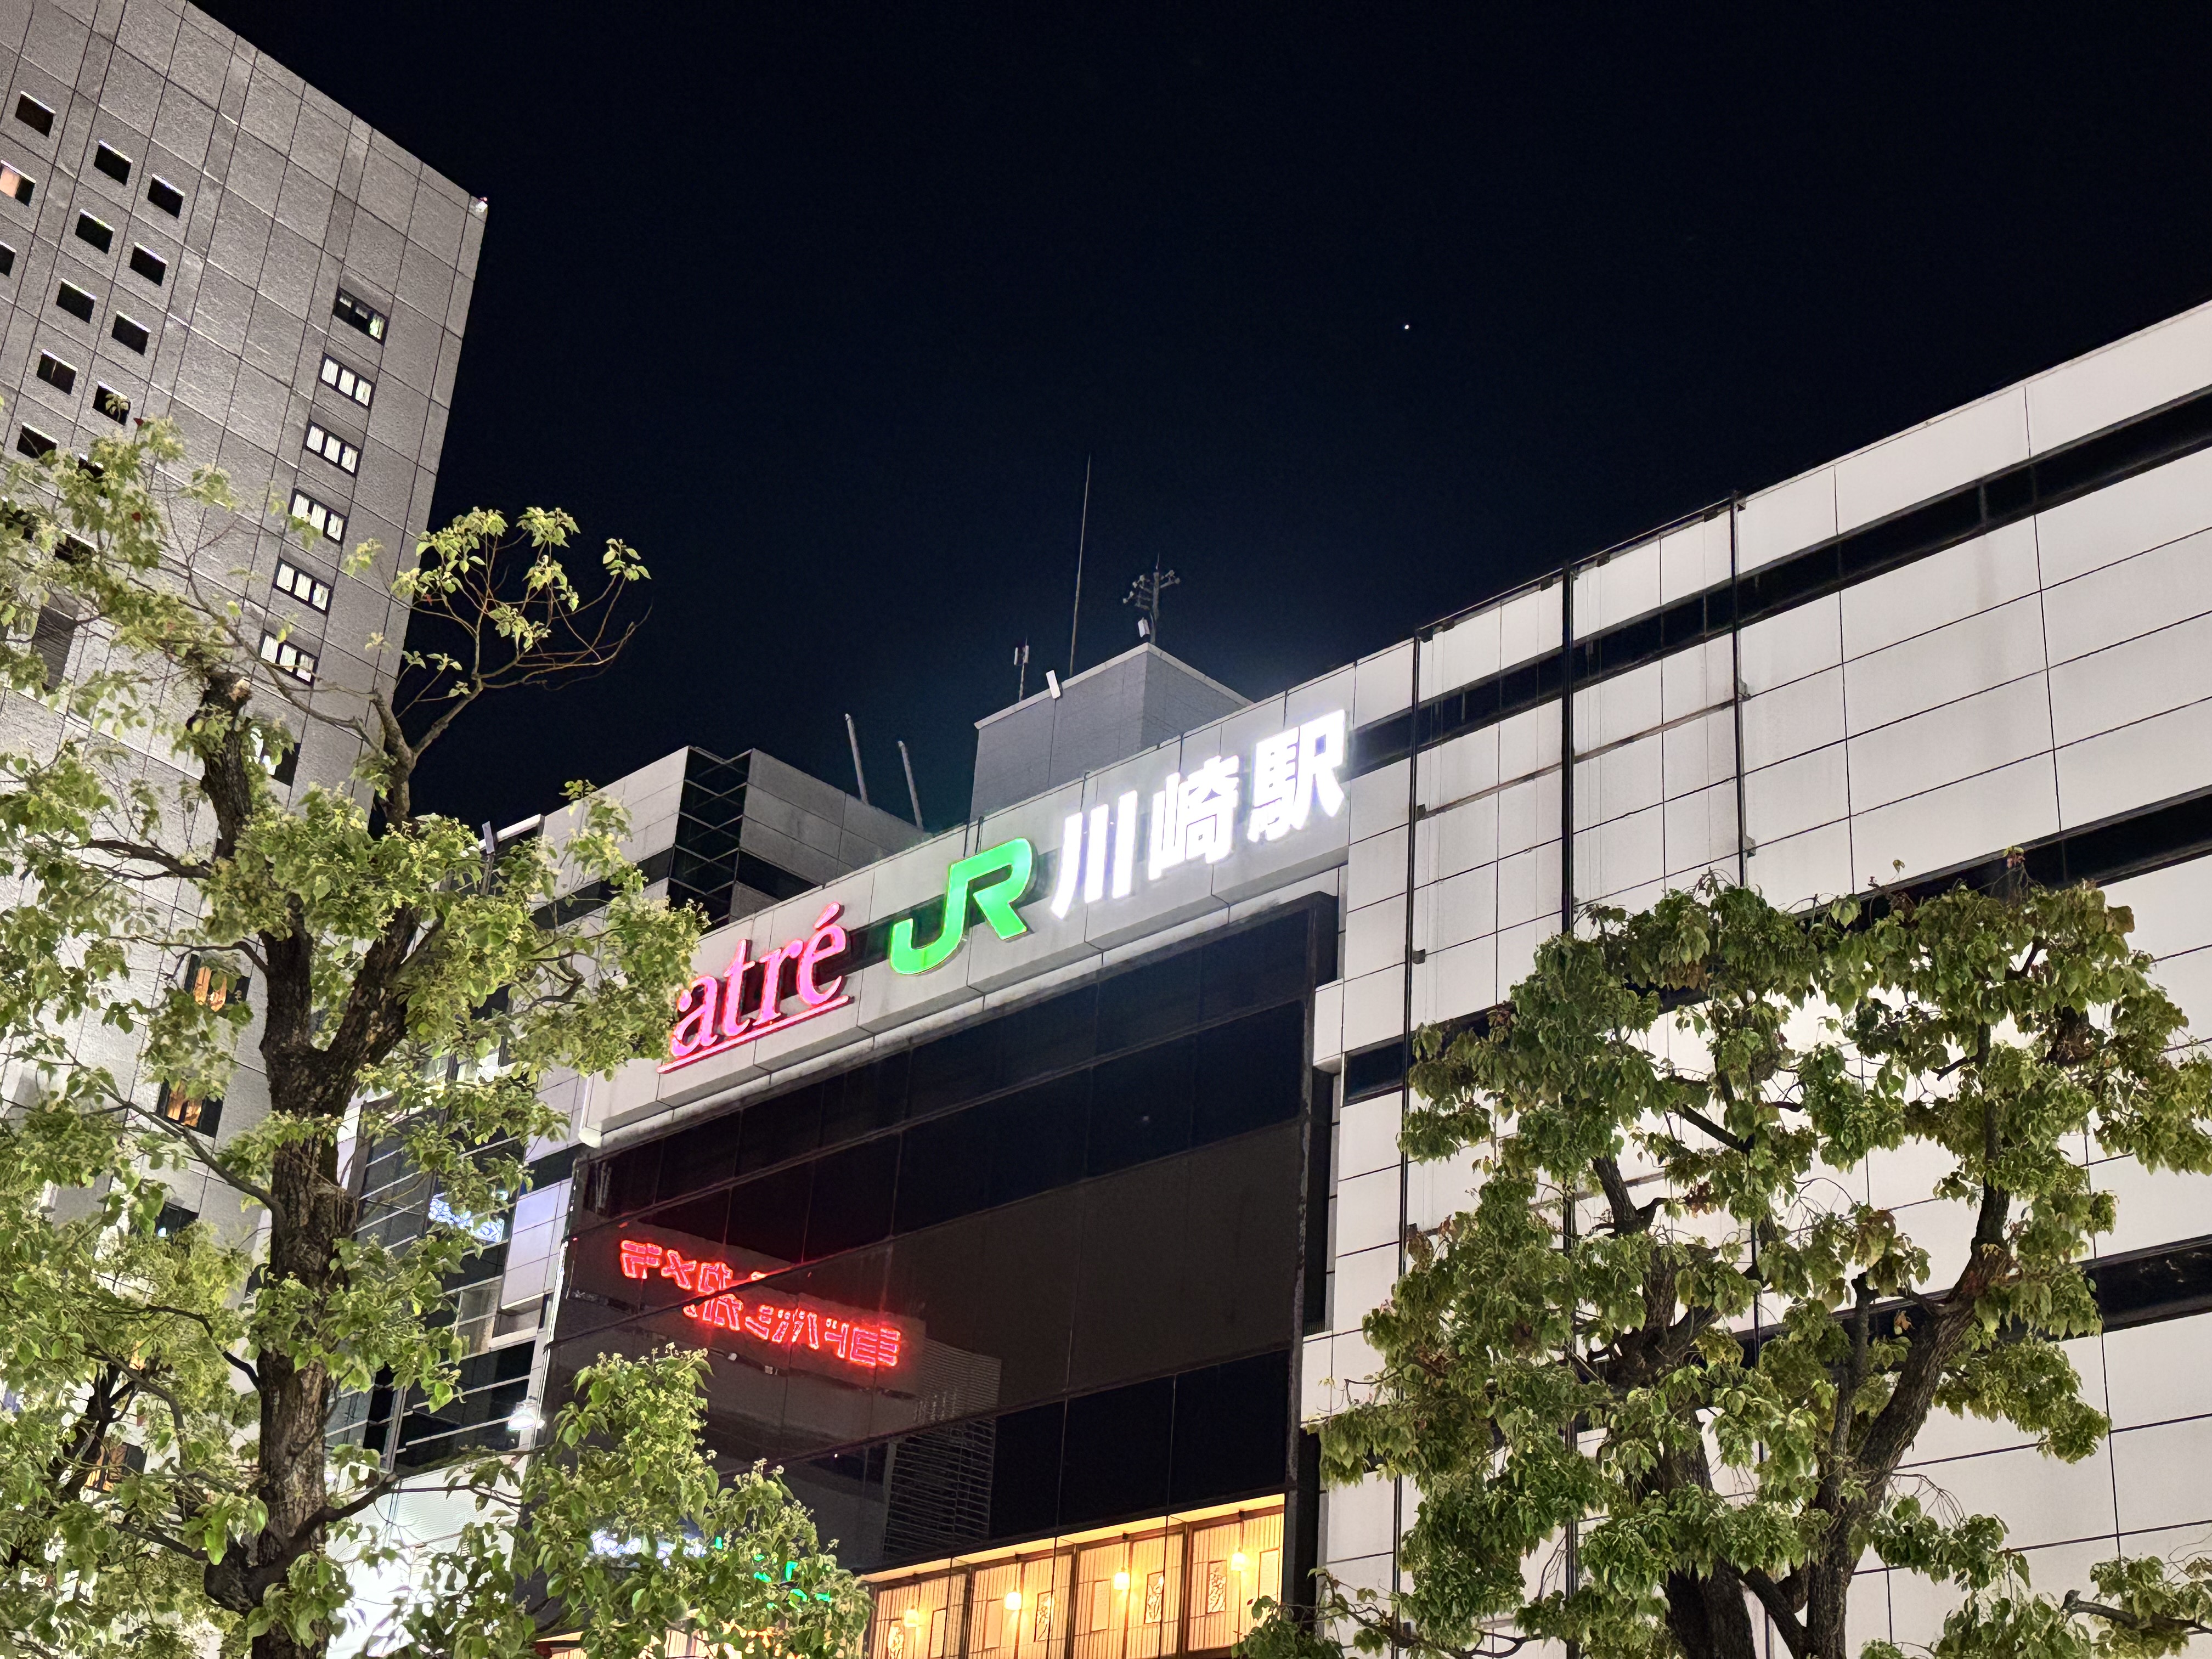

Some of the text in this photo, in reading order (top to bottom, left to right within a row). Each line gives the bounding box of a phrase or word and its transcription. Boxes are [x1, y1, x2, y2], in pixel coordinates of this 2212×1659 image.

[889, 709, 1346, 975] JR 川崎駅
[670, 901, 847, 1057] atré
